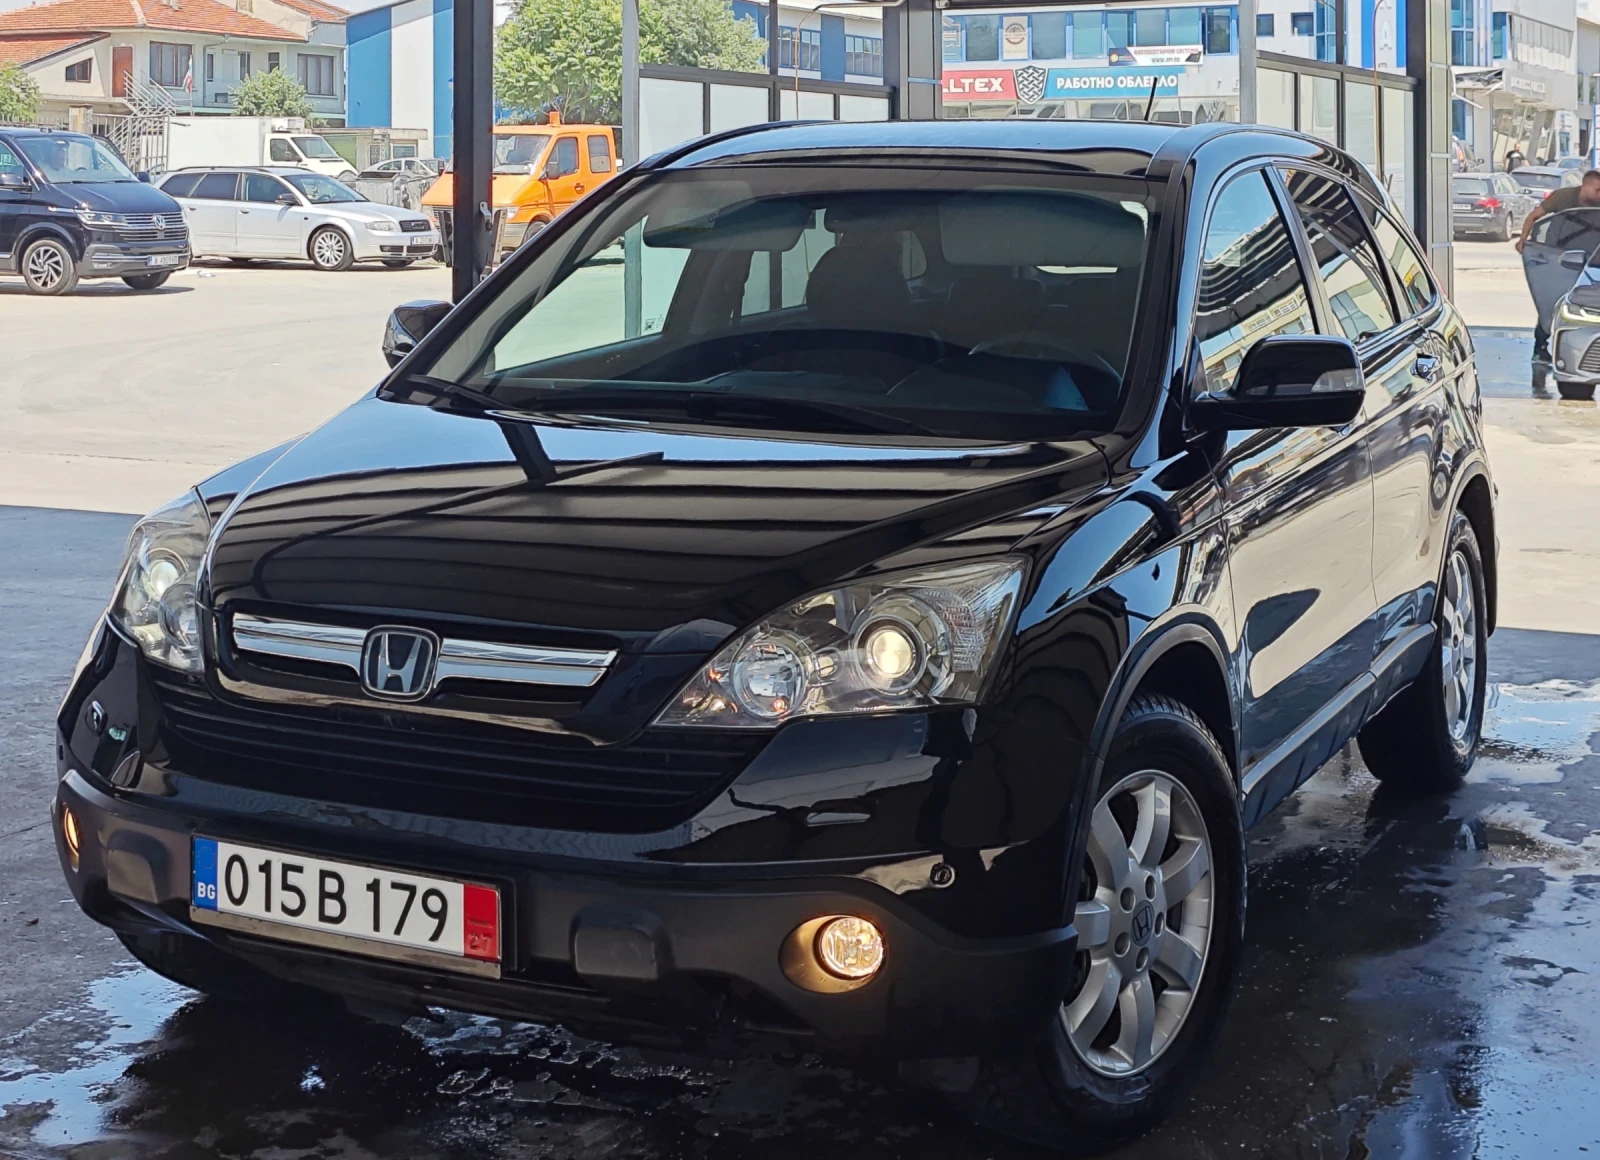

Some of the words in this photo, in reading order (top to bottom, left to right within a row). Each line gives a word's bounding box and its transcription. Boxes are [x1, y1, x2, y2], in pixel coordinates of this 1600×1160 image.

[942, 77, 1004, 93] LTEX
[1056, 76, 1115, 89] РАБОТНО
[197, 881, 216, 900] BG
